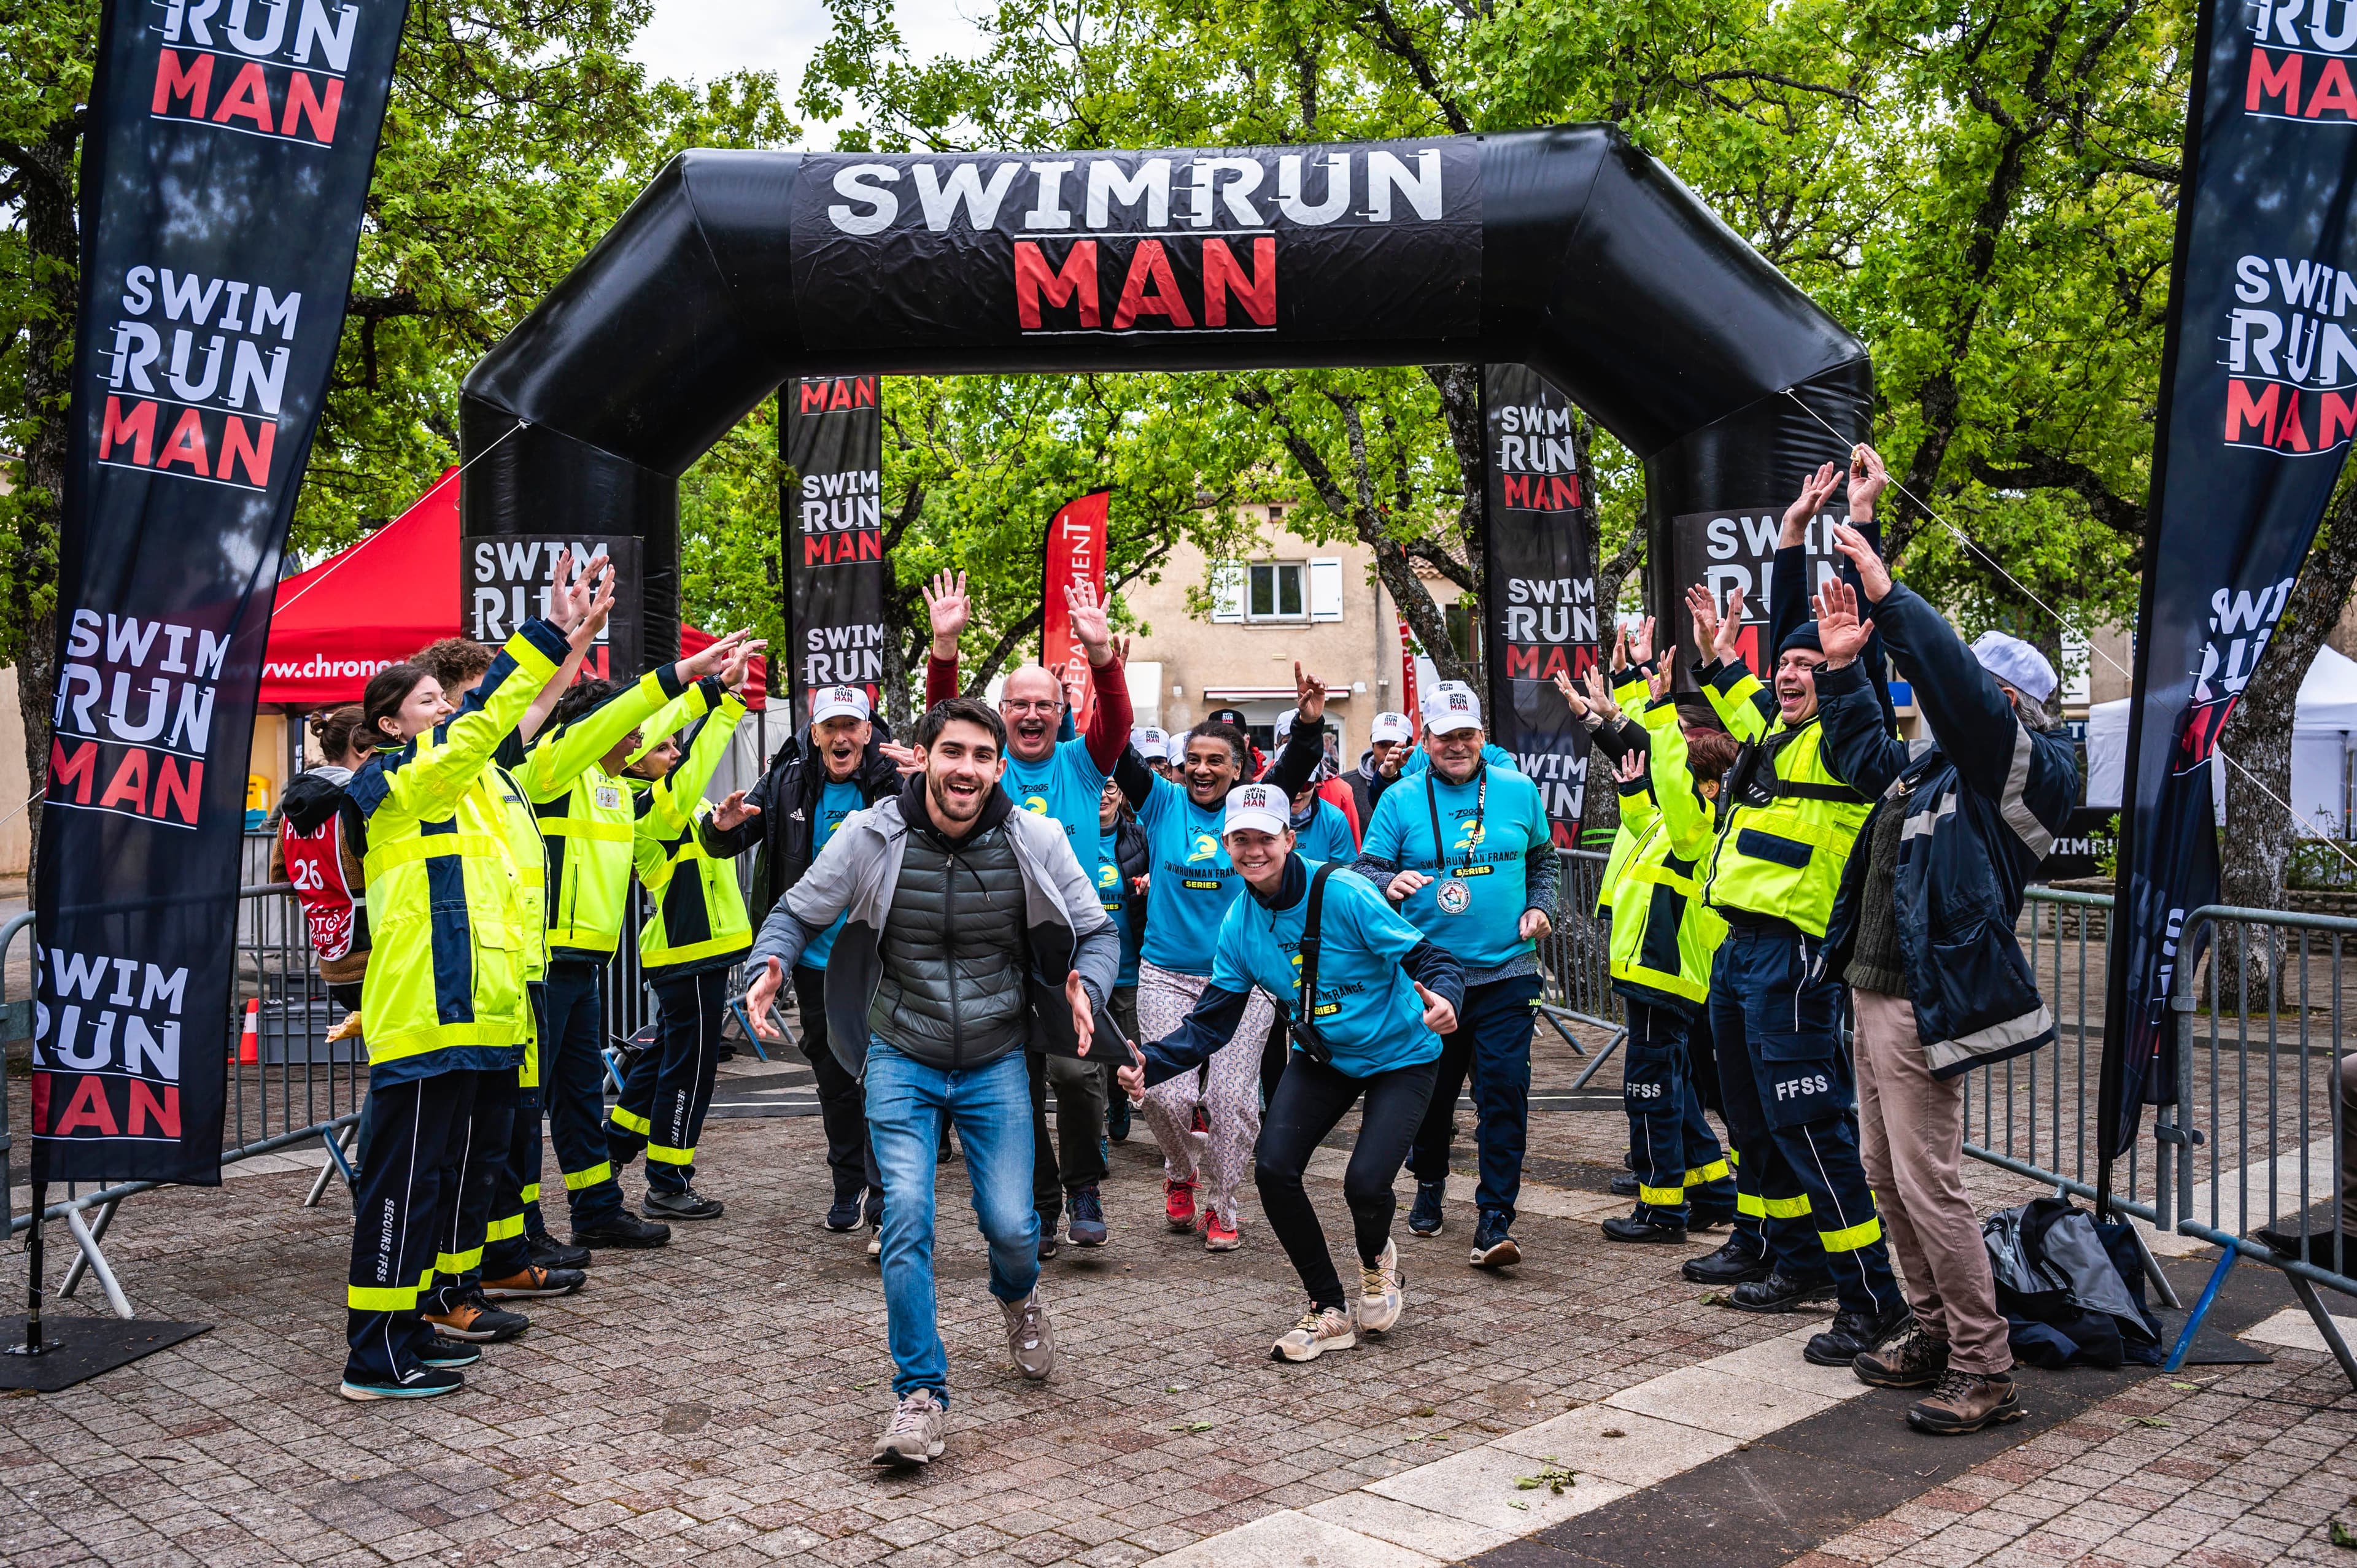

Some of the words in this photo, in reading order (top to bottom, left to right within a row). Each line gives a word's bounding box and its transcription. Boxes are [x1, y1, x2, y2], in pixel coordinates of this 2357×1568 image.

[2247, 0, 2357, 52] RU
[152, 48, 346, 144] MAN
[2245, 48, 2357, 118] MA
[827, 149, 1441, 235] SWIMRUN
[1015, 236, 1276, 329] MAN
[123, 265, 301, 340] SWIM
[98, 320, 290, 415] RUN
[801, 376, 875, 413] MAN
[99, 396, 277, 487] MAN
[1498, 435, 1576, 473] RUN
[802, 470, 878, 498] SWIM
[1503, 474, 1581, 510] MAN
[800, 495, 880, 532] RUN
[804, 530, 882, 565] MAN
[1508, 577, 1595, 604] SWIM
[807, 623, 883, 651] SWIM
[1503, 606, 1597, 642] RUN
[67, 608, 231, 679] SWIM
[1506, 644, 1598, 679] MAN
[803, 648, 883, 684] RUN
[53, 663, 215, 754] RUN
[45, 736, 204, 825] MAN
[1021, 783, 1049, 795] ZOGGS
[1243, 799, 1265, 808] MAN
[293, 859, 323, 889] 26
[1457, 866, 1490, 876] SERIES
[1488, 851, 1518, 862] FRANCE
[1627, 1082, 1661, 1098] FFSS
[1775, 1075, 1829, 1101] FFSS
[673, 1089, 686, 1126] SECOURS
[380, 1198, 395, 1252] SECOURS
[376, 1253, 389, 1283] FFSS
